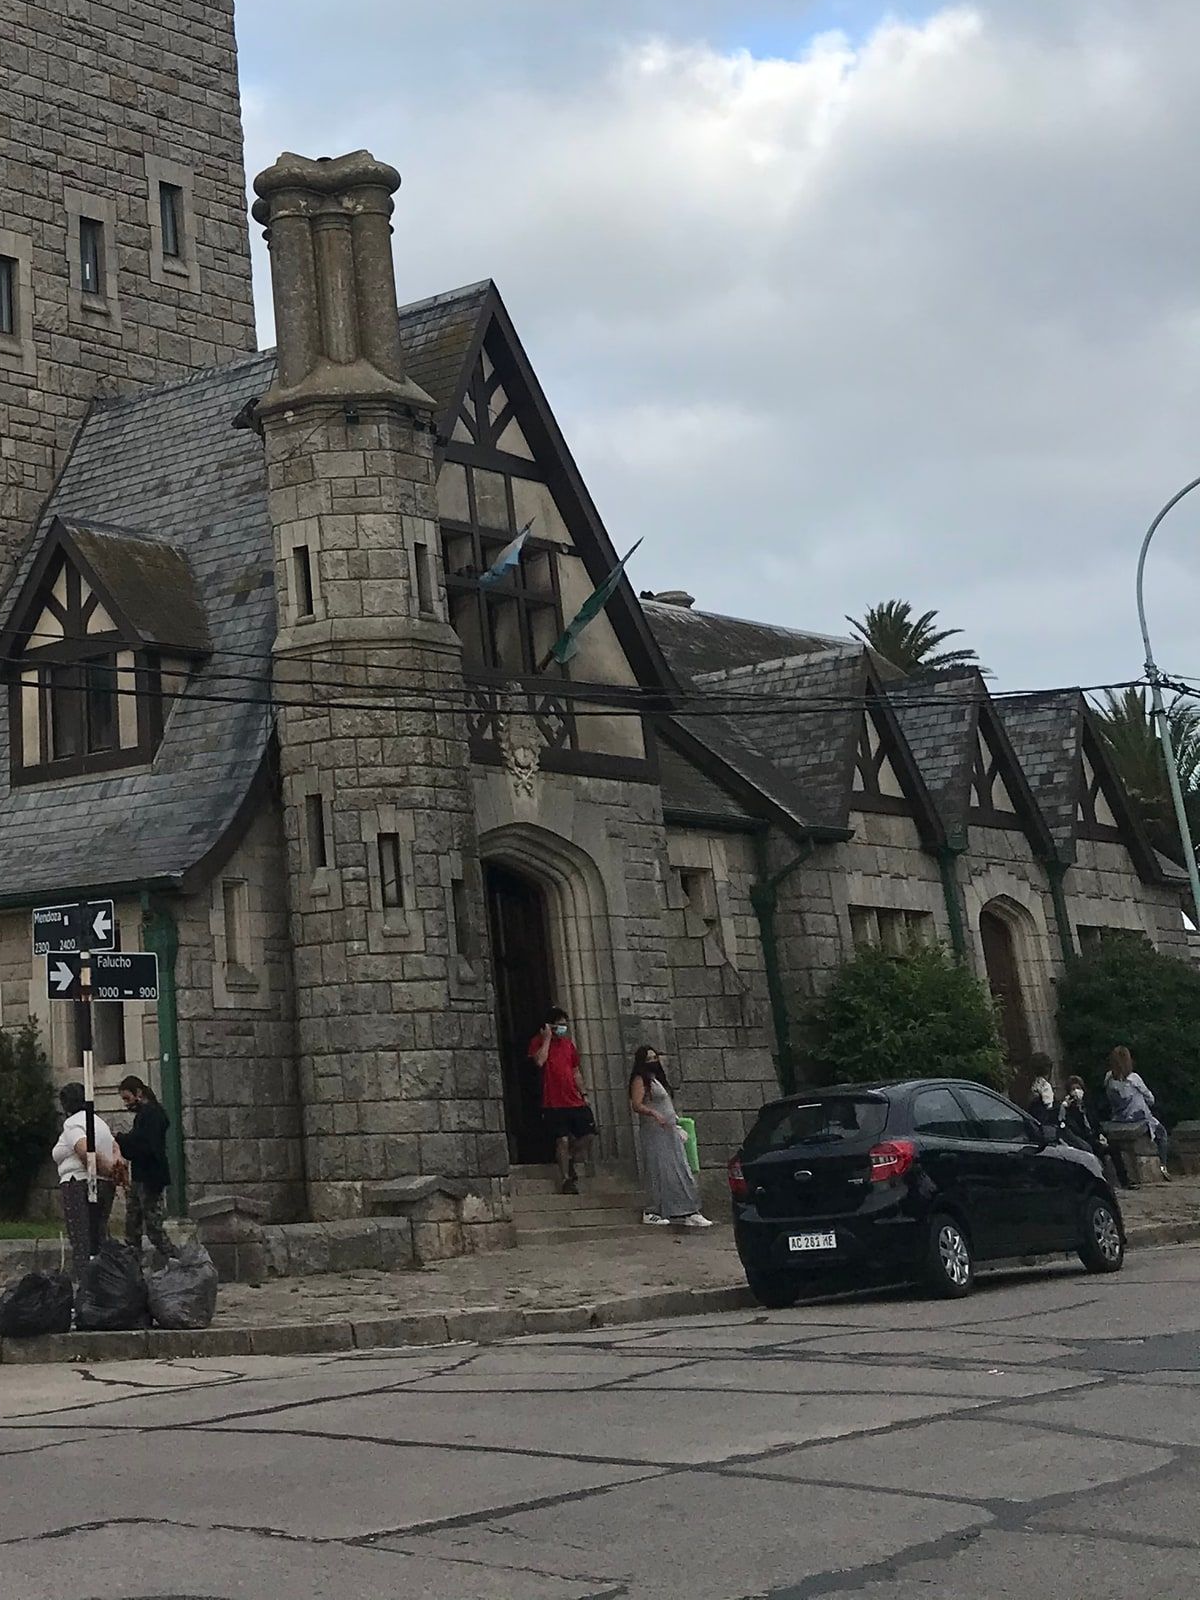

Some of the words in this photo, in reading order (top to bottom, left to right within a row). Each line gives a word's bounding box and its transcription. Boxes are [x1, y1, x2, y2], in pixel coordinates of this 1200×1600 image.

[34, 911, 62, 923] Mendoza
[35, 941, 50, 953] 2300
[60, 938, 76, 951] 2400
[97, 956, 132, 968] Falucho
[98, 986, 119, 998] 1000
[139, 986, 157, 998] 900
[791, 1237, 803, 1249] AC
